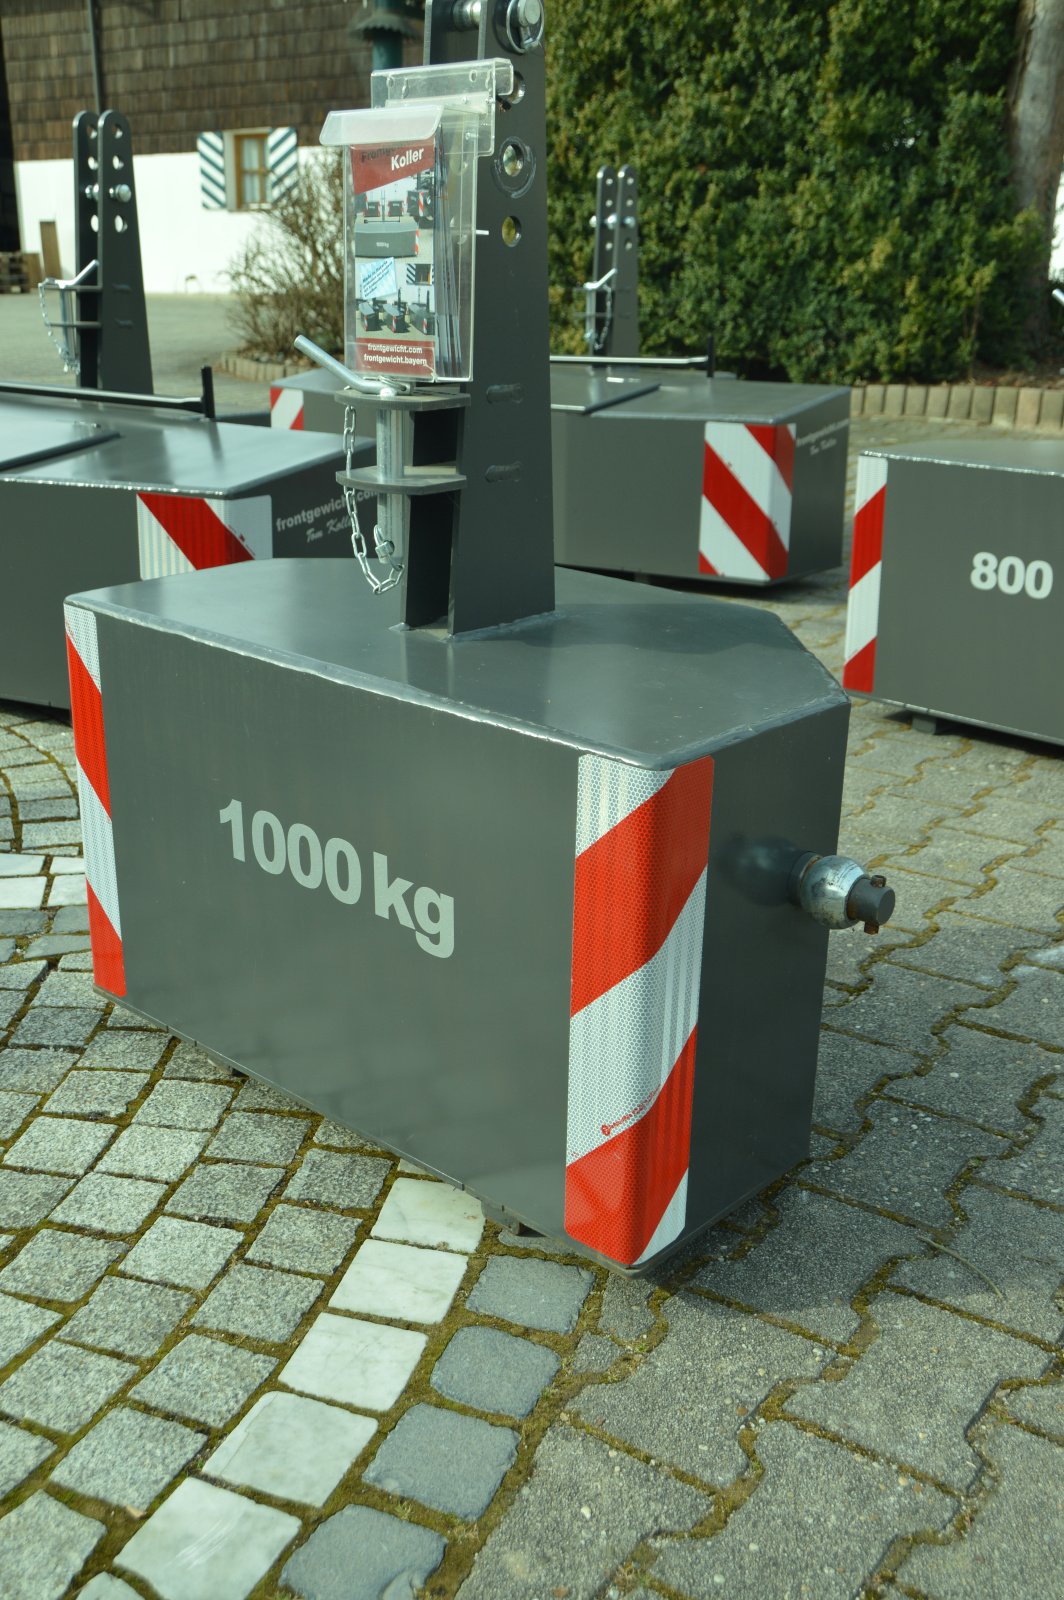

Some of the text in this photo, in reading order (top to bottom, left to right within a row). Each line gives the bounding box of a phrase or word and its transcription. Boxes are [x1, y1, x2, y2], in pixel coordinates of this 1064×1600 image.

[391, 148, 424, 171] Koller
[364, 353, 428, 366] frontgewicht.bayern
[368, 343, 423, 354] frontgewicht.com
[970, 551, 1054, 600] 800
[219, 798, 455, 959] 1000 kg
